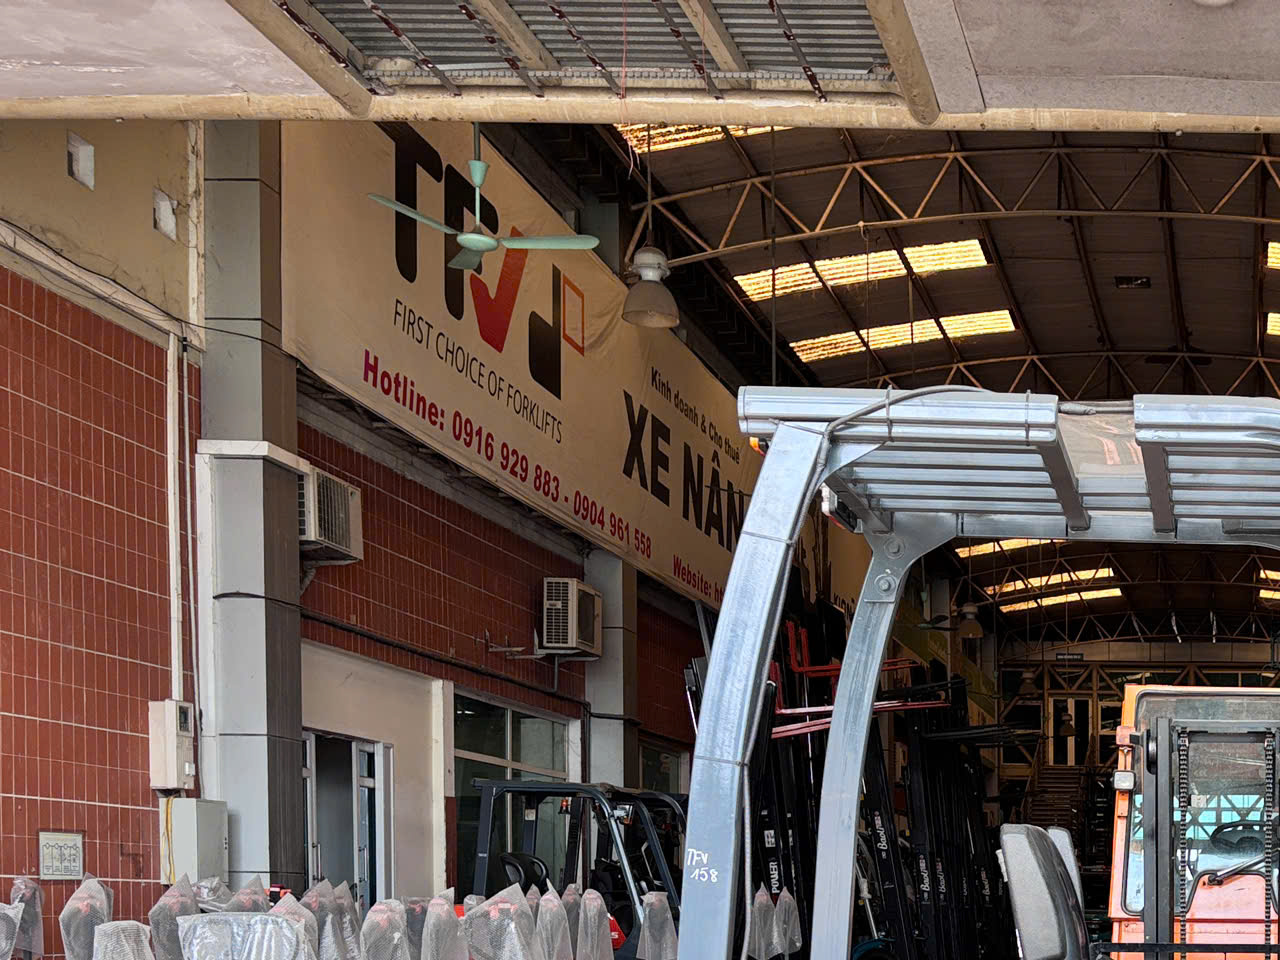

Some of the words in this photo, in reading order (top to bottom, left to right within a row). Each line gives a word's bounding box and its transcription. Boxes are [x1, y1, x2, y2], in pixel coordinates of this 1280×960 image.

[394, 298, 433, 350] FIRST
[436, 331, 485, 390] CHOICE
[488, 369, 505, 401] OF
[506, 384, 563, 446] FORKLIFTS
[651, 366, 672, 403] Kinh
[674, 390, 699, 427] doanh
[701, 414, 707, 435] &
[709, 421, 723, 449] Cho
[362, 349, 446, 432] Hotline:
[452, 410, 495, 462] 0916
[500, 442, 529, 483] 929
[533, 464, 560, 503] 883
[574, 490, 605, 531] 0904
[609, 512, 630, 545] 961
[634, 527, 652, 560] 558
[623, 389, 671, 508] XE
[673, 554, 711, 598] Website:
[687, 848, 708, 866] TFV
[690, 867, 718, 882] 158
[768, 861, 780, 894] POWER
